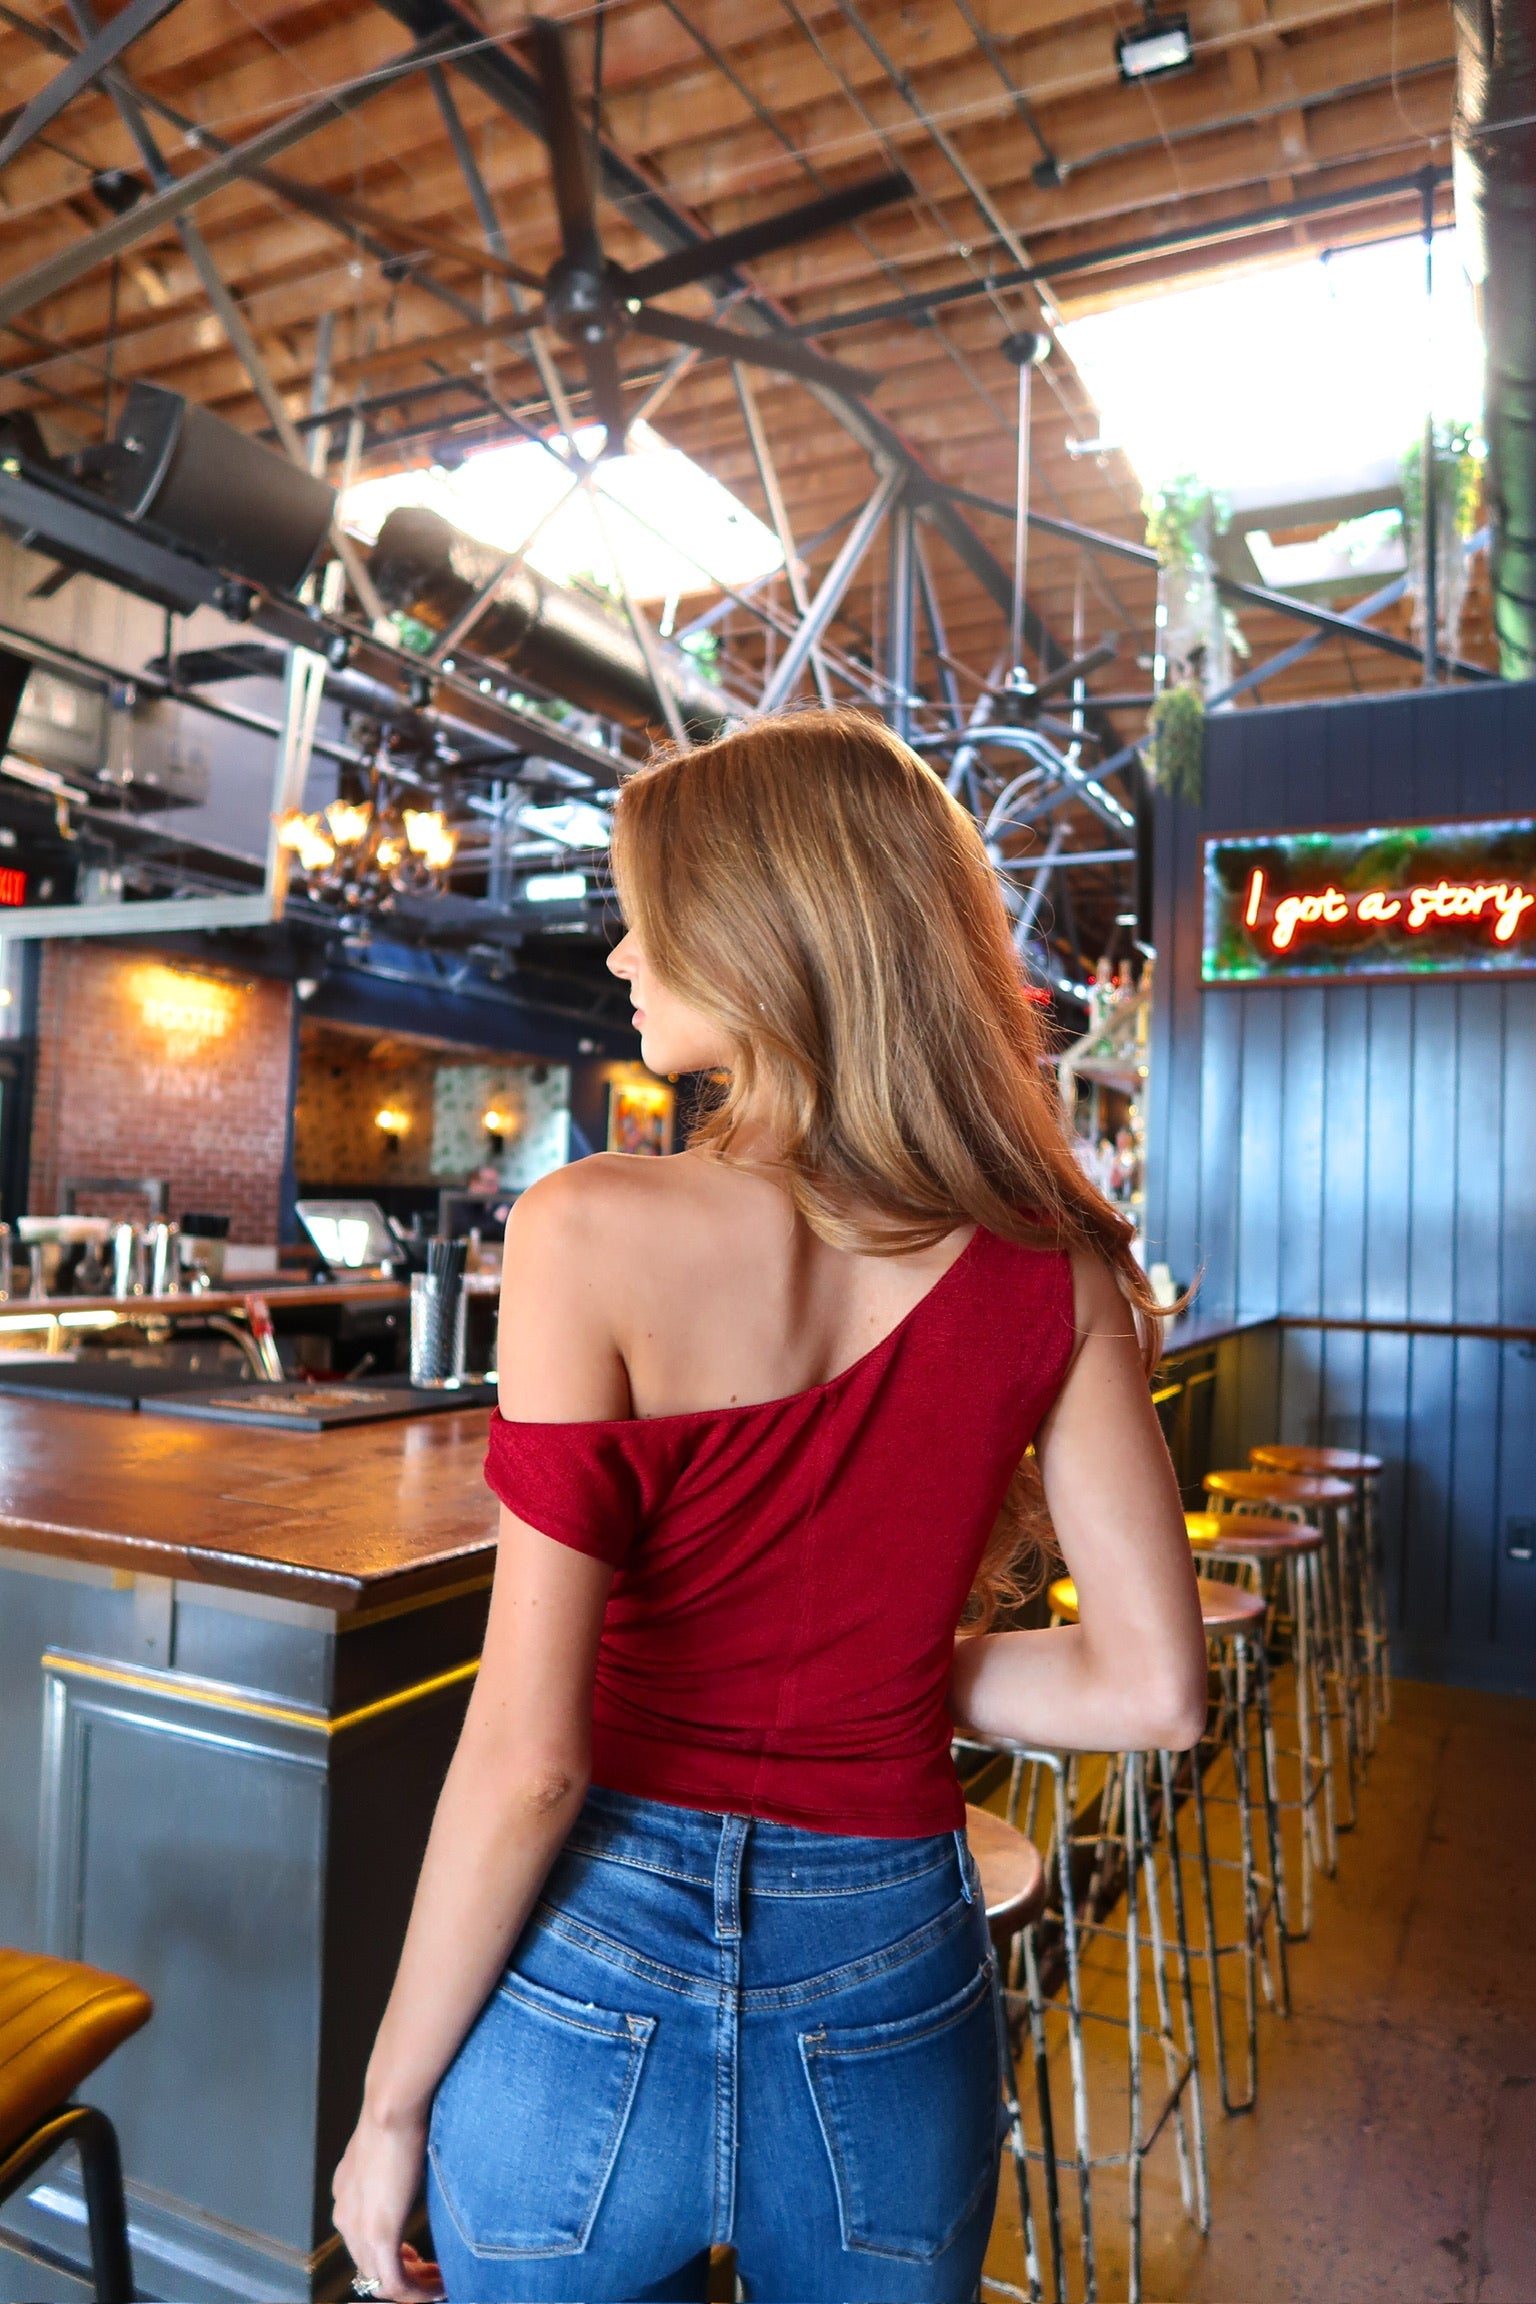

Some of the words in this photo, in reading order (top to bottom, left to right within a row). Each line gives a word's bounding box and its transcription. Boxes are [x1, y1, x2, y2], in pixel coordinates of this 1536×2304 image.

[1245, 869, 1263, 926] I
[1272, 886, 1349, 949] got
[1356, 890, 1402, 922] a
[1406, 879, 1536, 942] story
